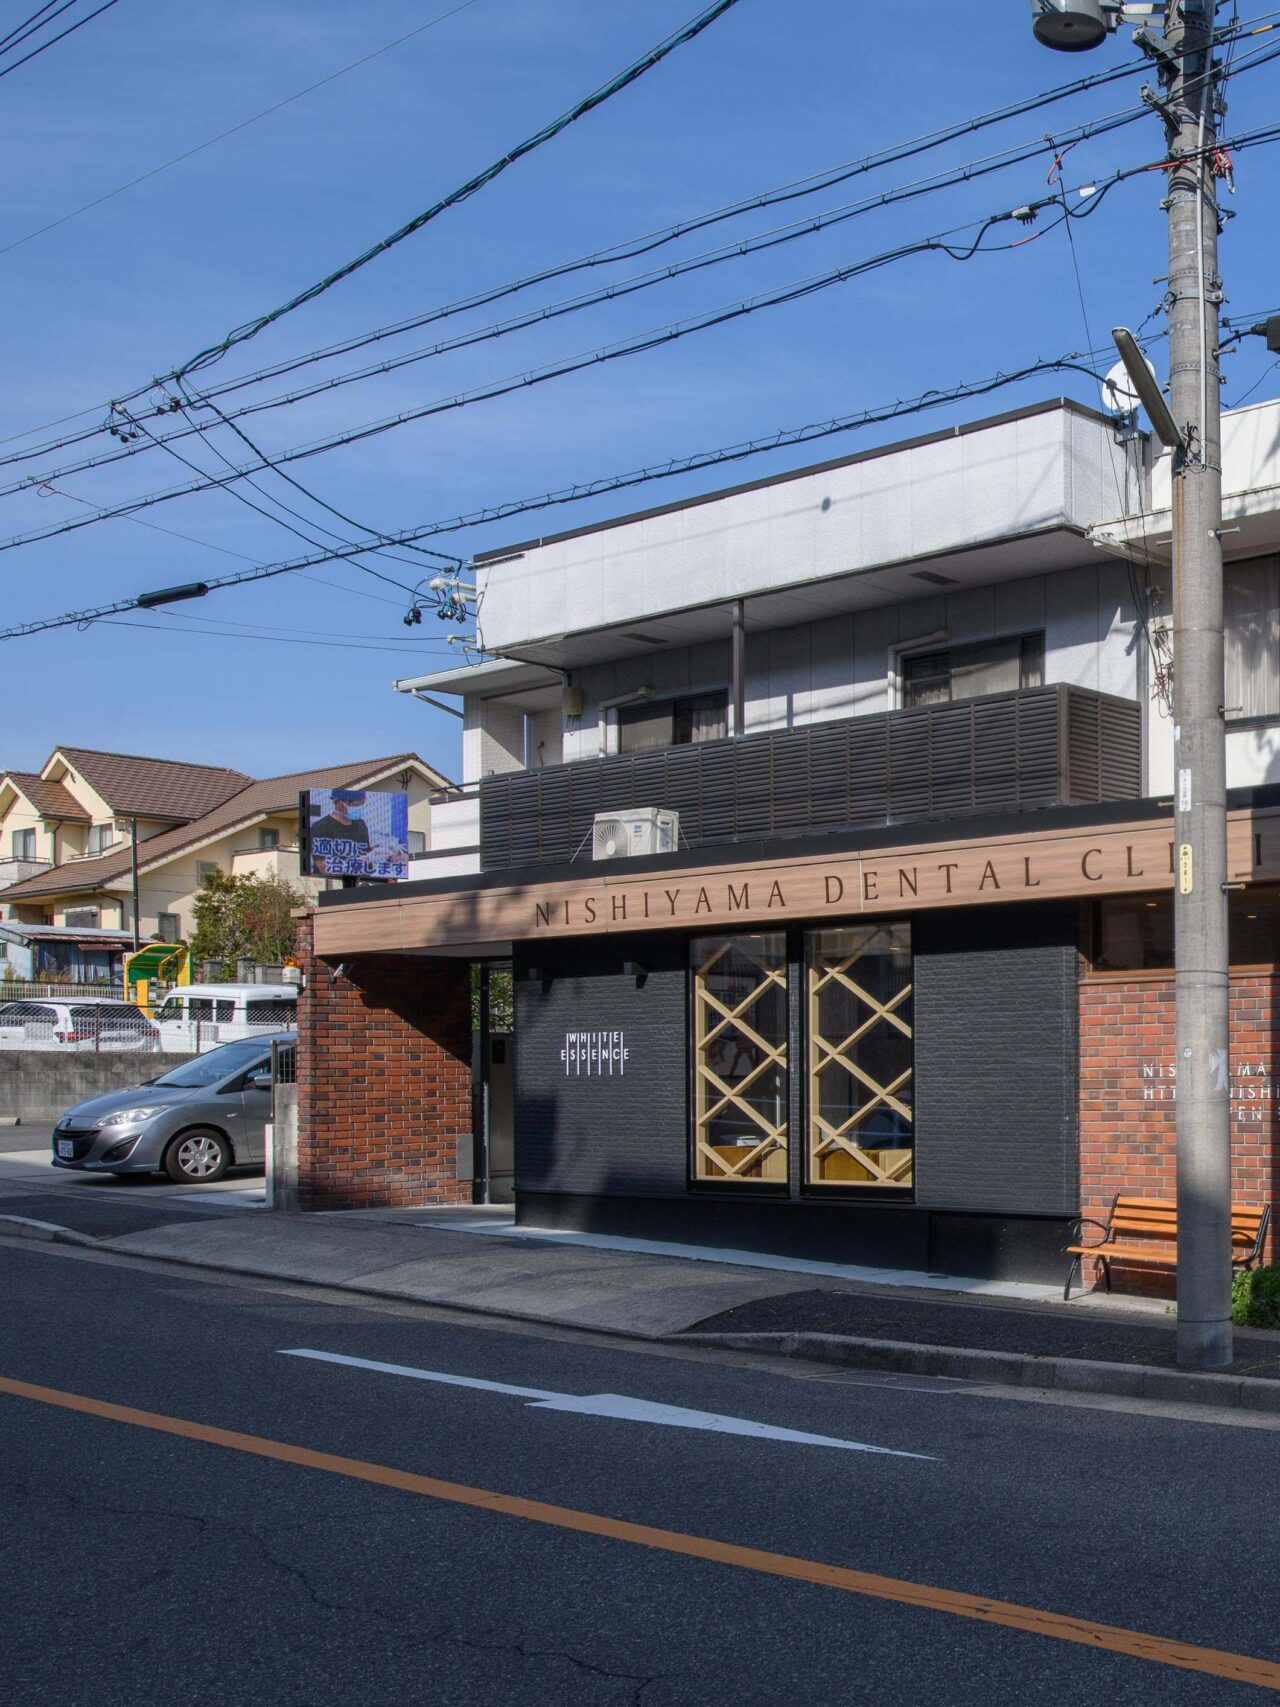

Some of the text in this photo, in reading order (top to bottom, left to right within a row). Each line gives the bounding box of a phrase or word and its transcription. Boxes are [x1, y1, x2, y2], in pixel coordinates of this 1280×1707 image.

[312, 837, 369, 857] 適切に
[325, 856, 407, 876] 治療します
[535, 879, 787, 928] NISHIYAMA
[823, 856, 1041, 905] DENTAL
[569, 1031, 620, 1043] WHITE
[560, 1048, 630, 1061] ESSENCE
[1143, 1062, 1268, 1078] NISMA
